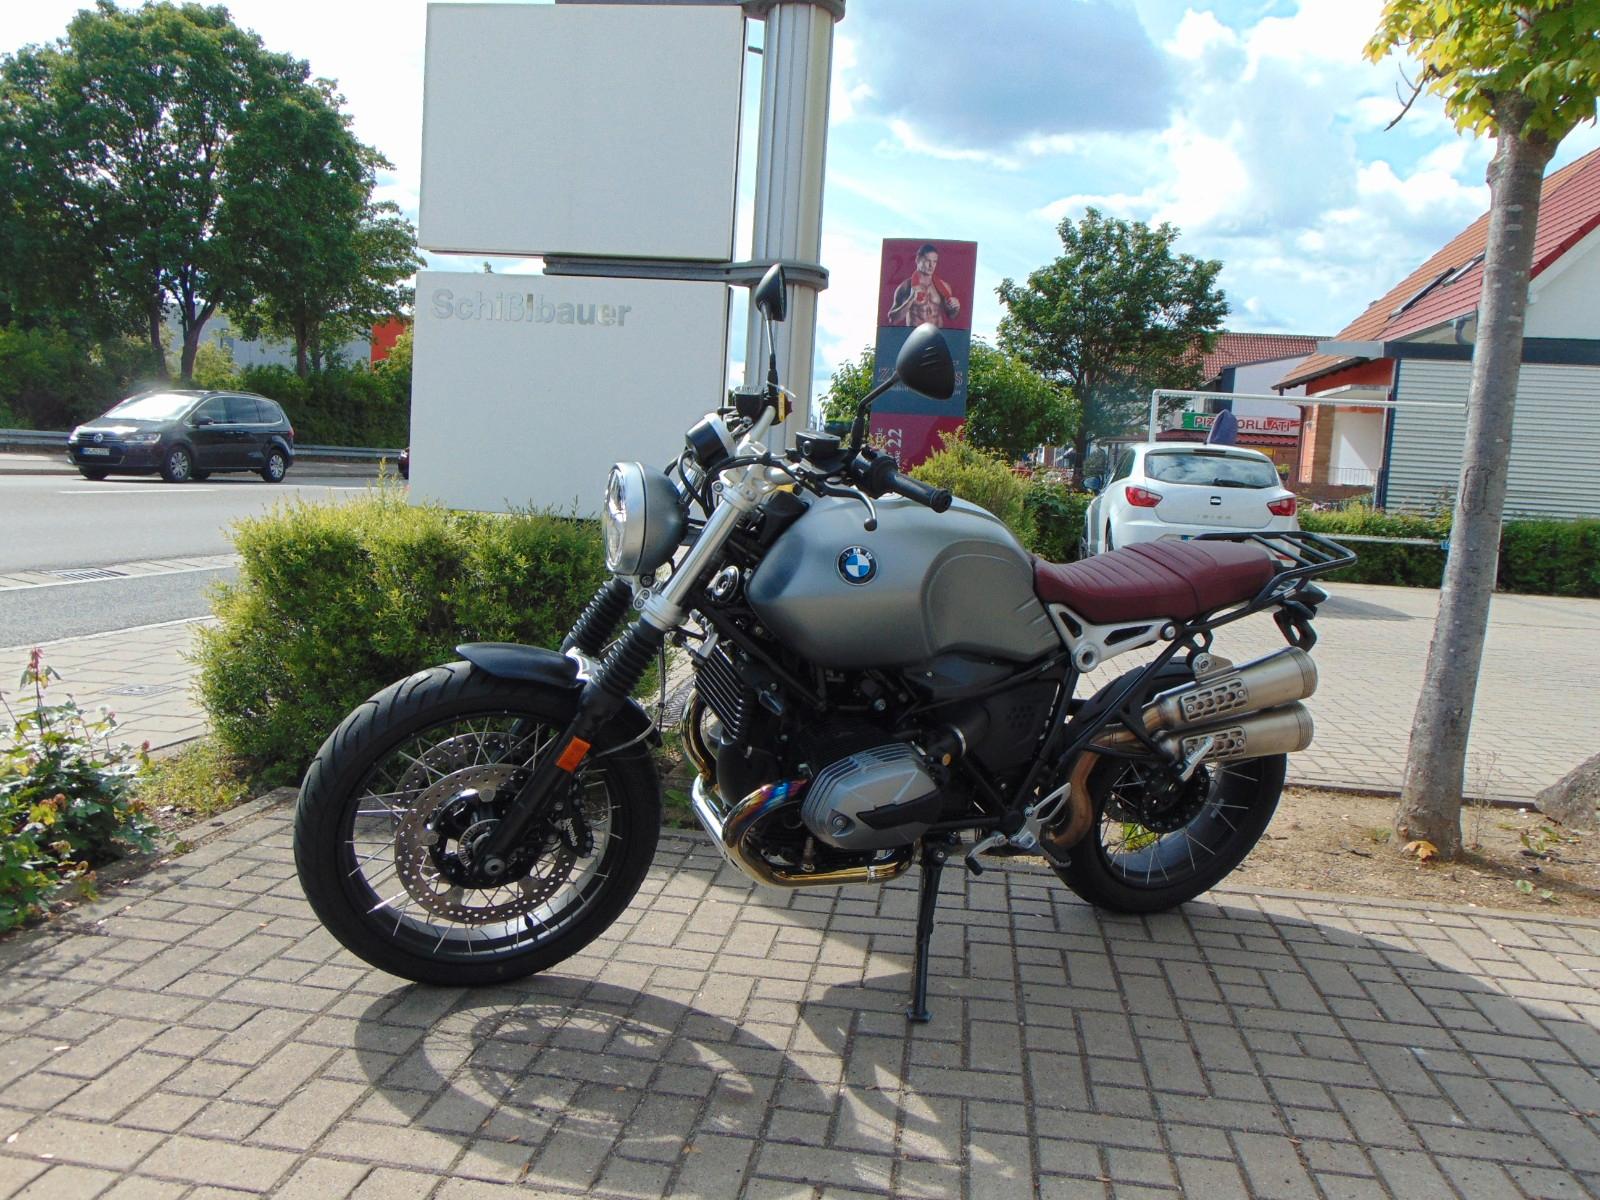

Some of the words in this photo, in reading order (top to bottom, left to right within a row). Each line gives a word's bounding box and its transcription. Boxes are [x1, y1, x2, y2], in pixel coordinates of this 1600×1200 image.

[430, 288, 632, 327] Schißlbauer
[1194, 416, 1216, 428] PIZ
[1237, 419, 1290, 432] ORLLATI
